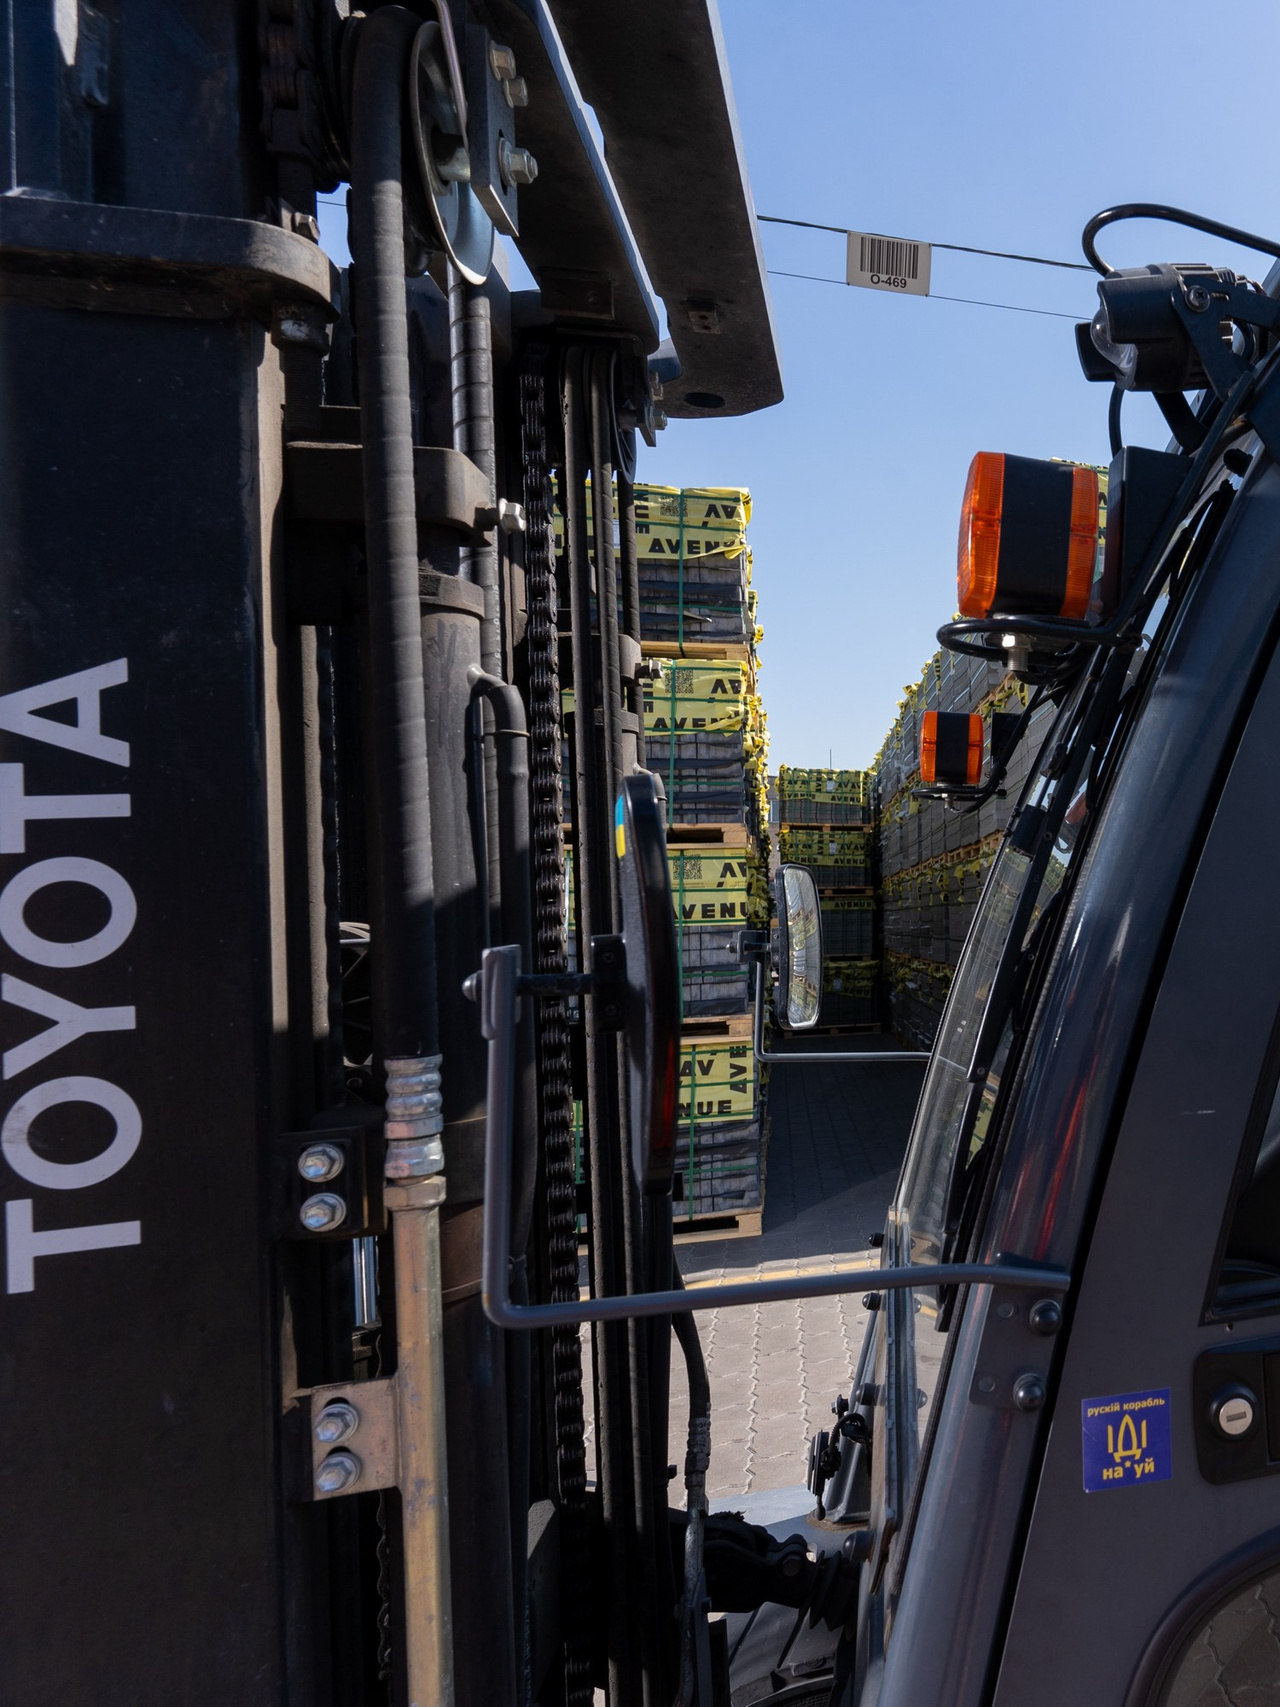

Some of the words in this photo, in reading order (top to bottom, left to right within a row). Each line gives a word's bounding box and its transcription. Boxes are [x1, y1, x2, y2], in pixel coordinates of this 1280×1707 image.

[870, 273, 907, 288] O-469
[0, 657, 142, 1294] TOYOTA
[1123, 1397, 1166, 1411] корабль
